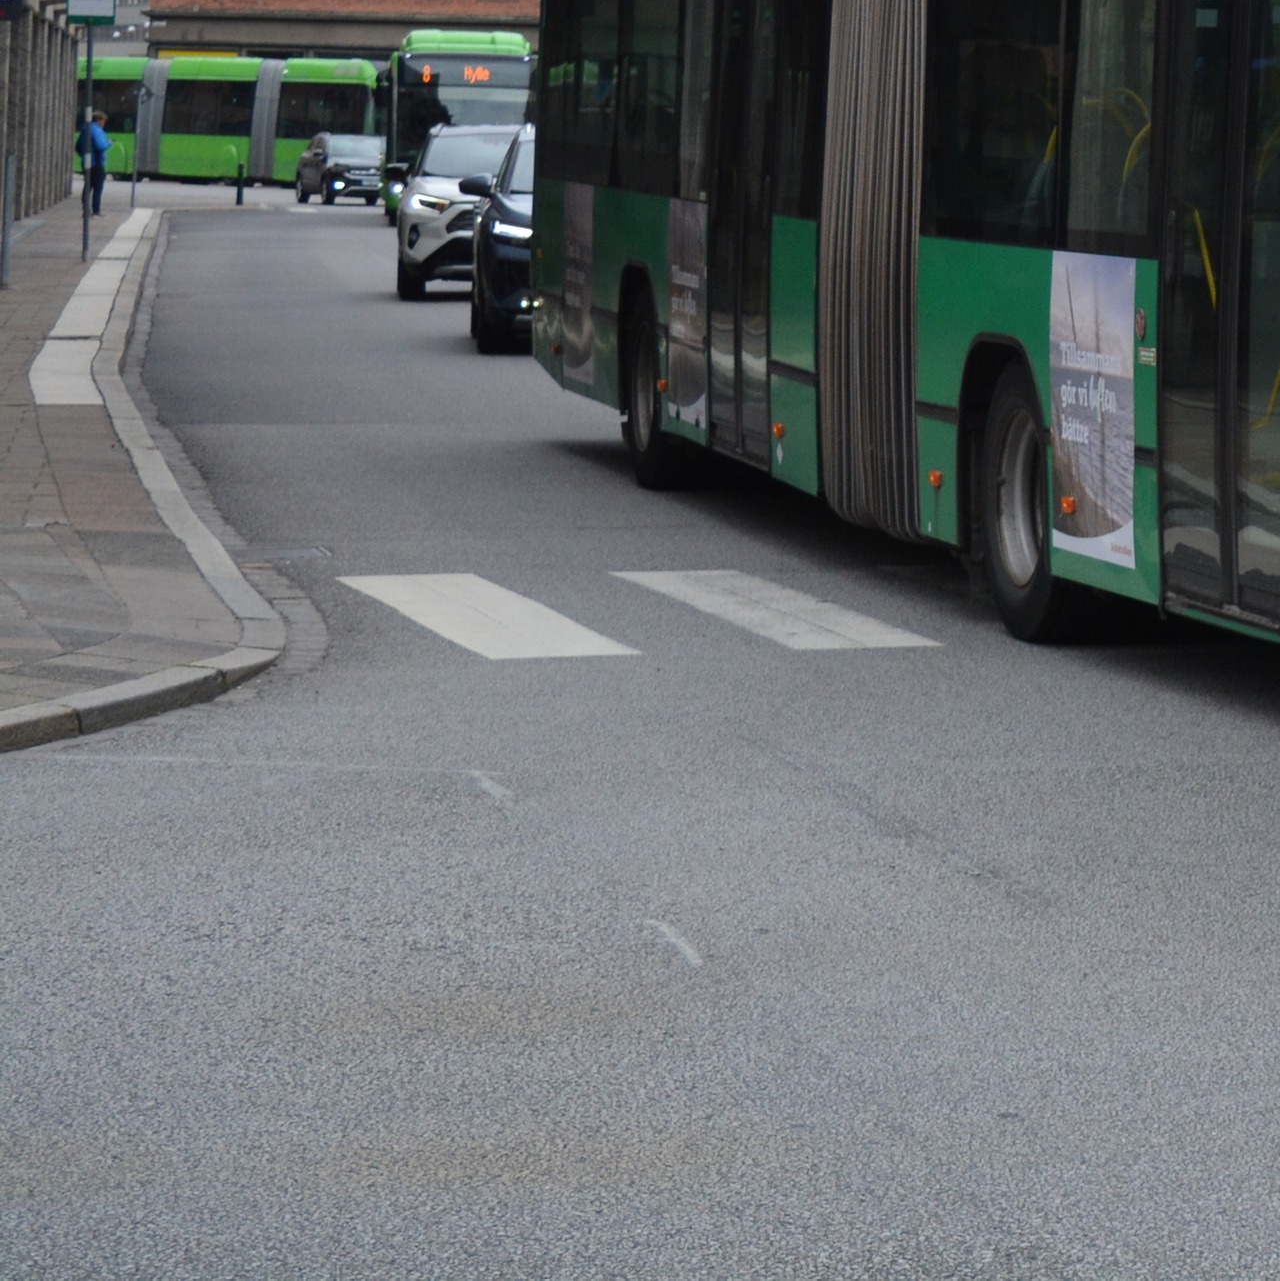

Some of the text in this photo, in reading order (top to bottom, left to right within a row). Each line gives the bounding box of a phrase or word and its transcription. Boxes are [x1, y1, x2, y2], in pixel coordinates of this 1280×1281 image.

[422, 64, 432, 84] 8
[1061, 380, 1077, 409] gör
[1078, 381, 1088, 408] vi
